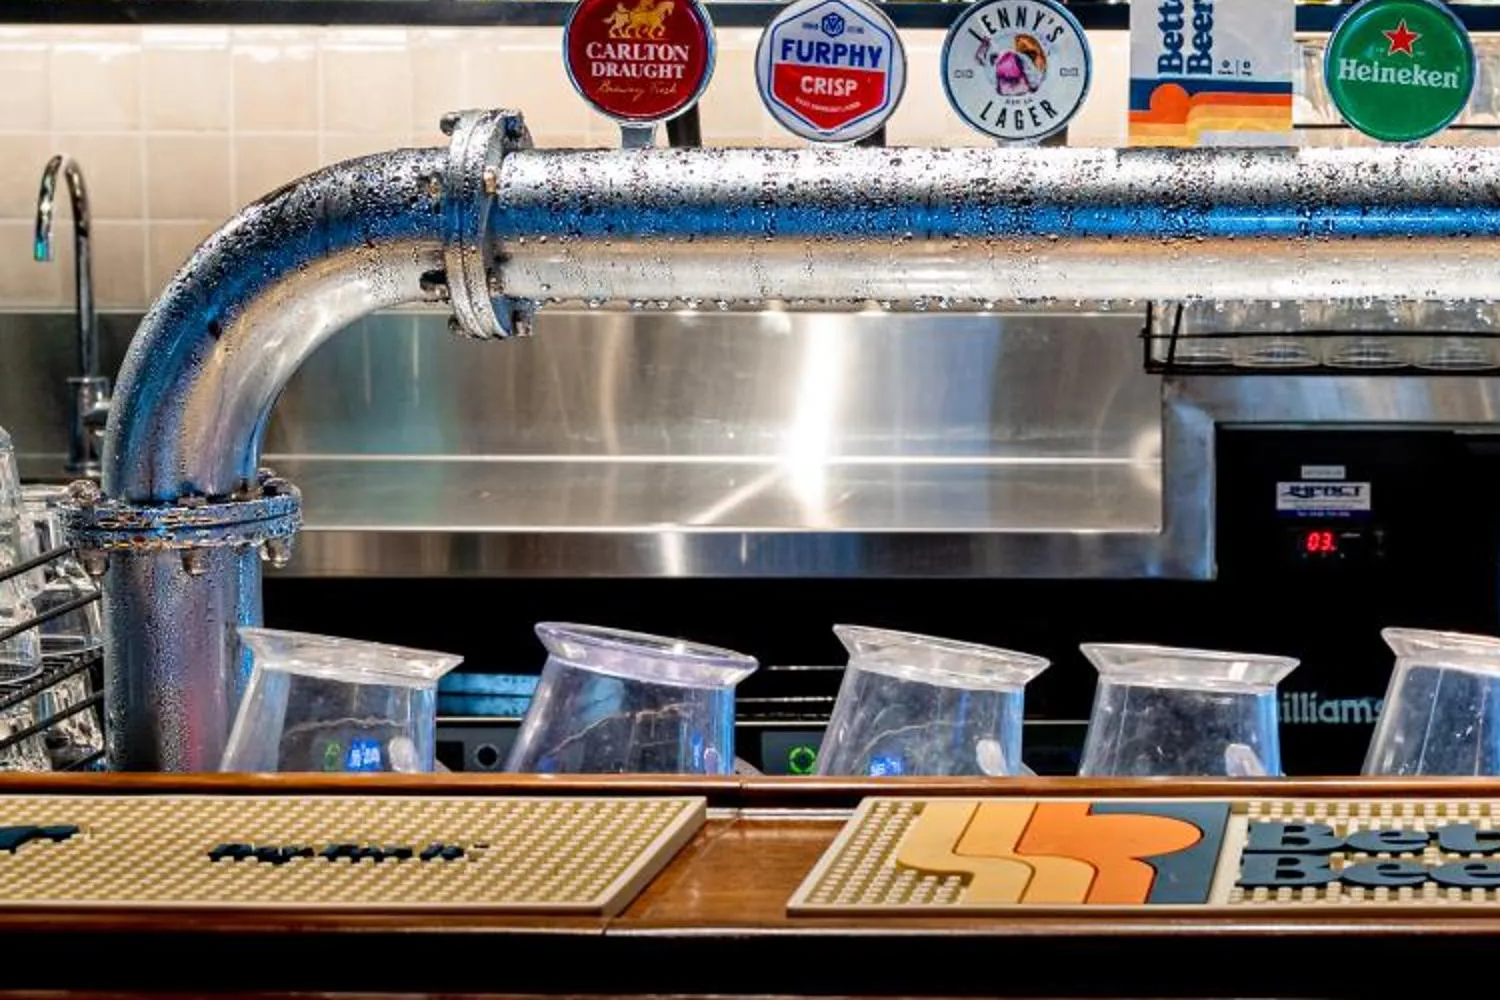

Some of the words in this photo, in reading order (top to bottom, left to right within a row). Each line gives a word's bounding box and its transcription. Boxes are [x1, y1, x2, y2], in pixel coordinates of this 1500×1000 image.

[585, 41, 689, 62] CARLTON
[781, 38, 883, 69] FURPHY
[590, 61, 687, 79] DRAUGHT
[1337, 57, 1460, 89] Heineken
[800, 75, 859, 97] CRISP
[979, 99, 1058, 131] LAGER
[1279, 691, 1385, 724] illiams
